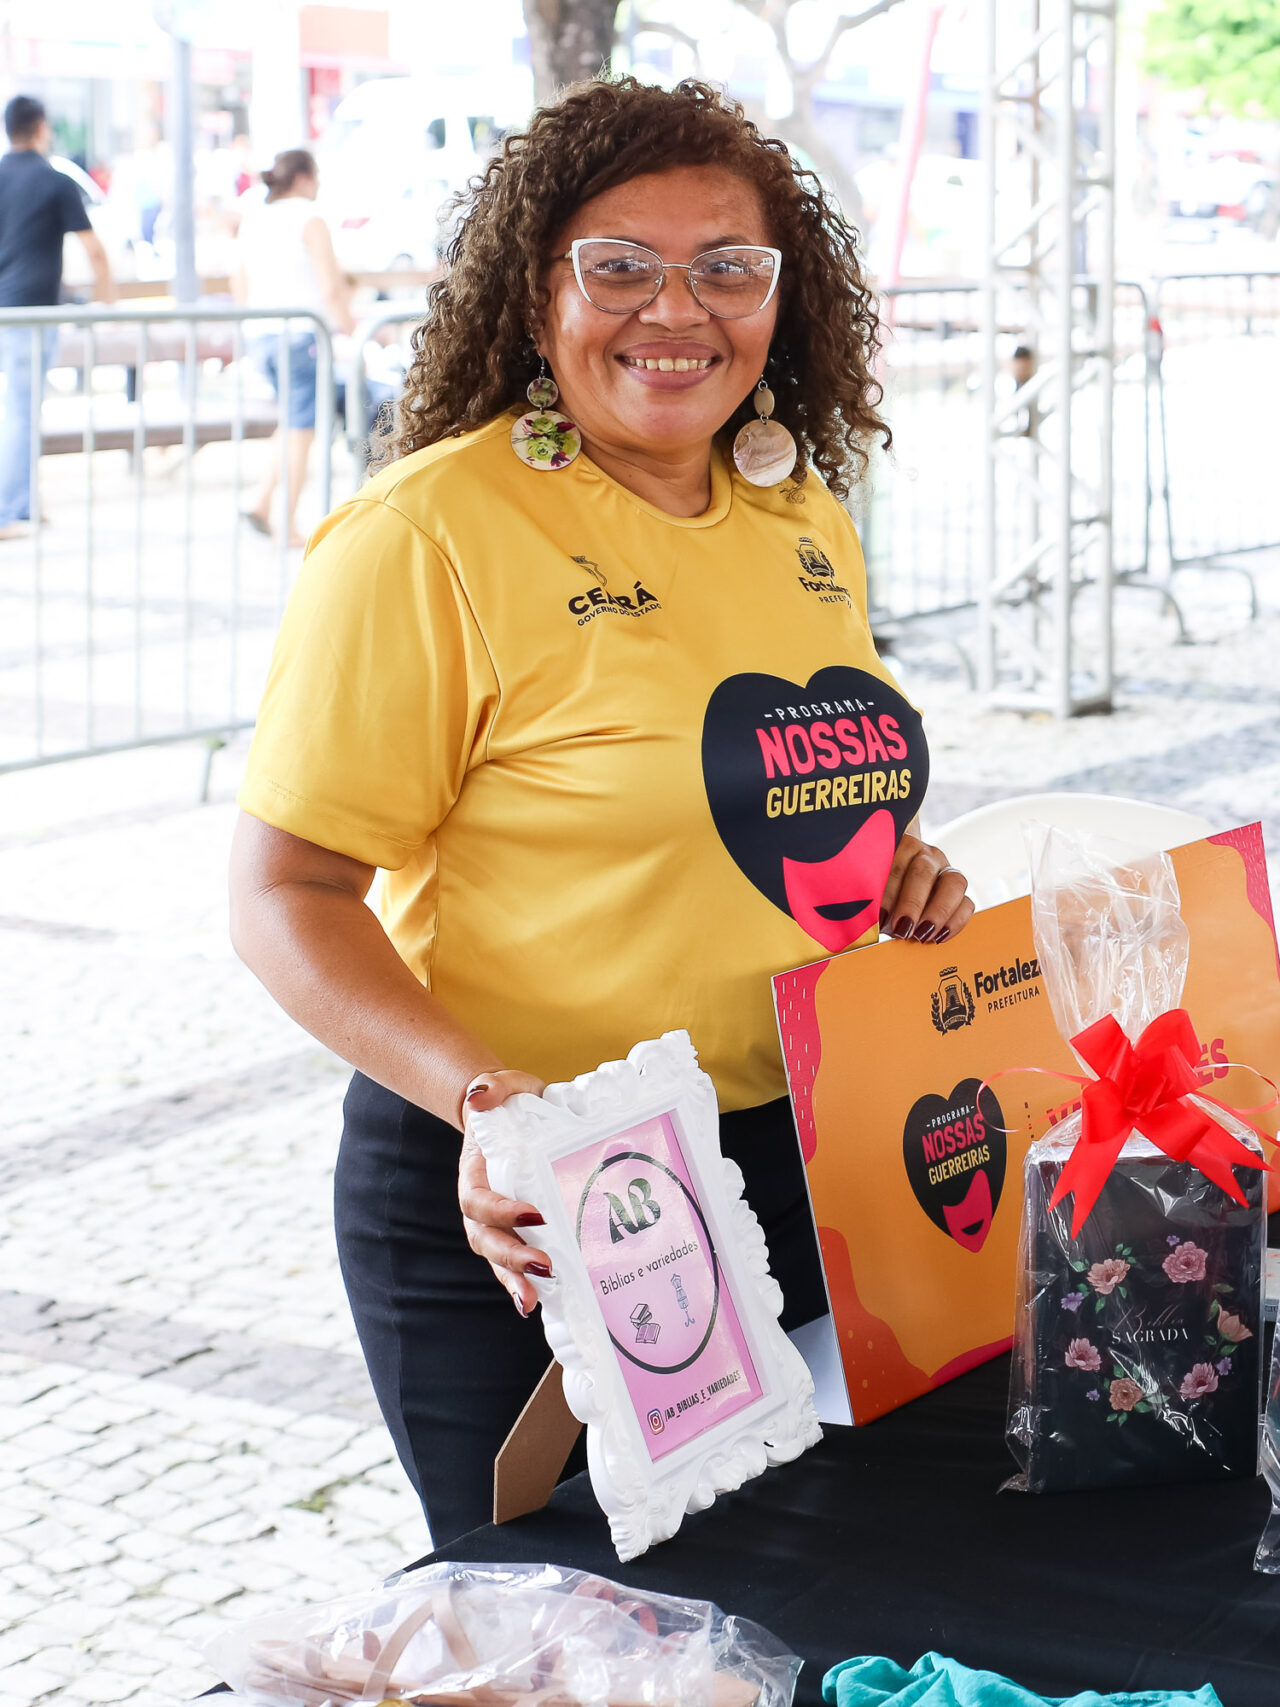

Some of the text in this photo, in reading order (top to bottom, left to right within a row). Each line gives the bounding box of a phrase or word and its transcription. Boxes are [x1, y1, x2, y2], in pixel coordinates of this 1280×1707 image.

[577, 605, 618, 626] GOVERNO
[755, 713, 908, 779] NOSSAS
[766, 768, 912, 819] GUERREIRAS
[987, 985, 1040, 1013] PREFEITURA
[922, 1113, 986, 1164] NOSSAS
[928, 1144, 991, 1186] GUERREIRAS
[603, 1177, 661, 1244] AB
[637, 1267, 644, 1278] e
[646, 1240, 699, 1273] variedades
[1111, 1327, 1189, 1344] SAGRADA
